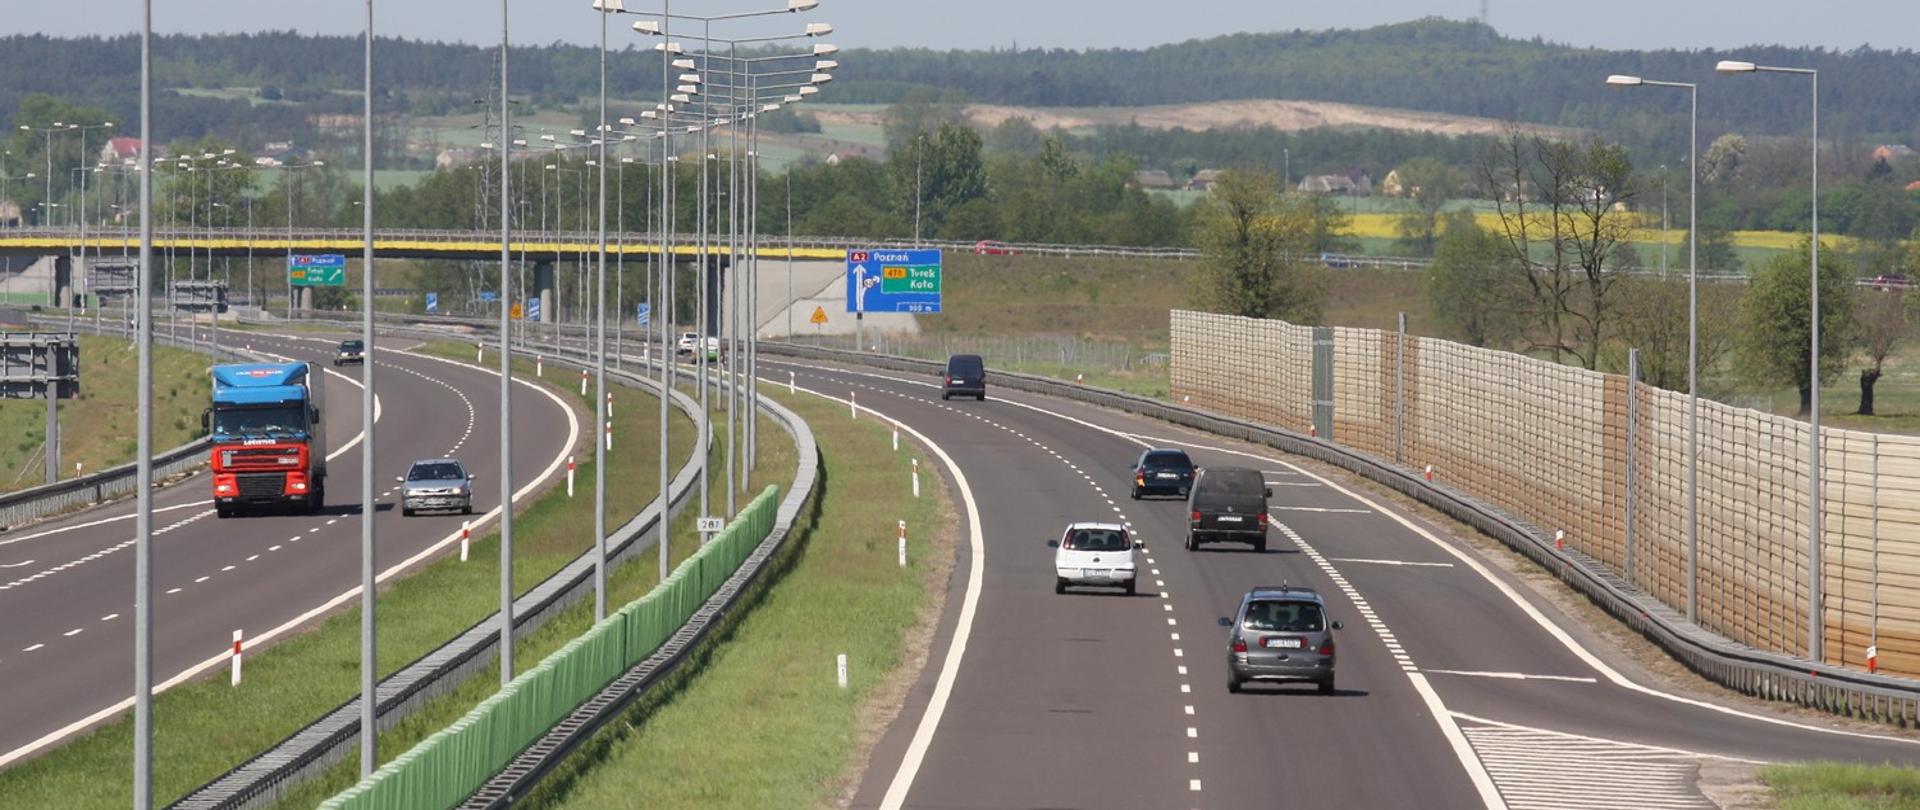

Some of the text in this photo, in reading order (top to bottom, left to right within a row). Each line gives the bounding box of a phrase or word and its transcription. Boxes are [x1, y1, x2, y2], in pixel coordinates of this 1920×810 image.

[853, 252, 909, 262] A2 Poznań
[909, 268, 935, 278] Turek
